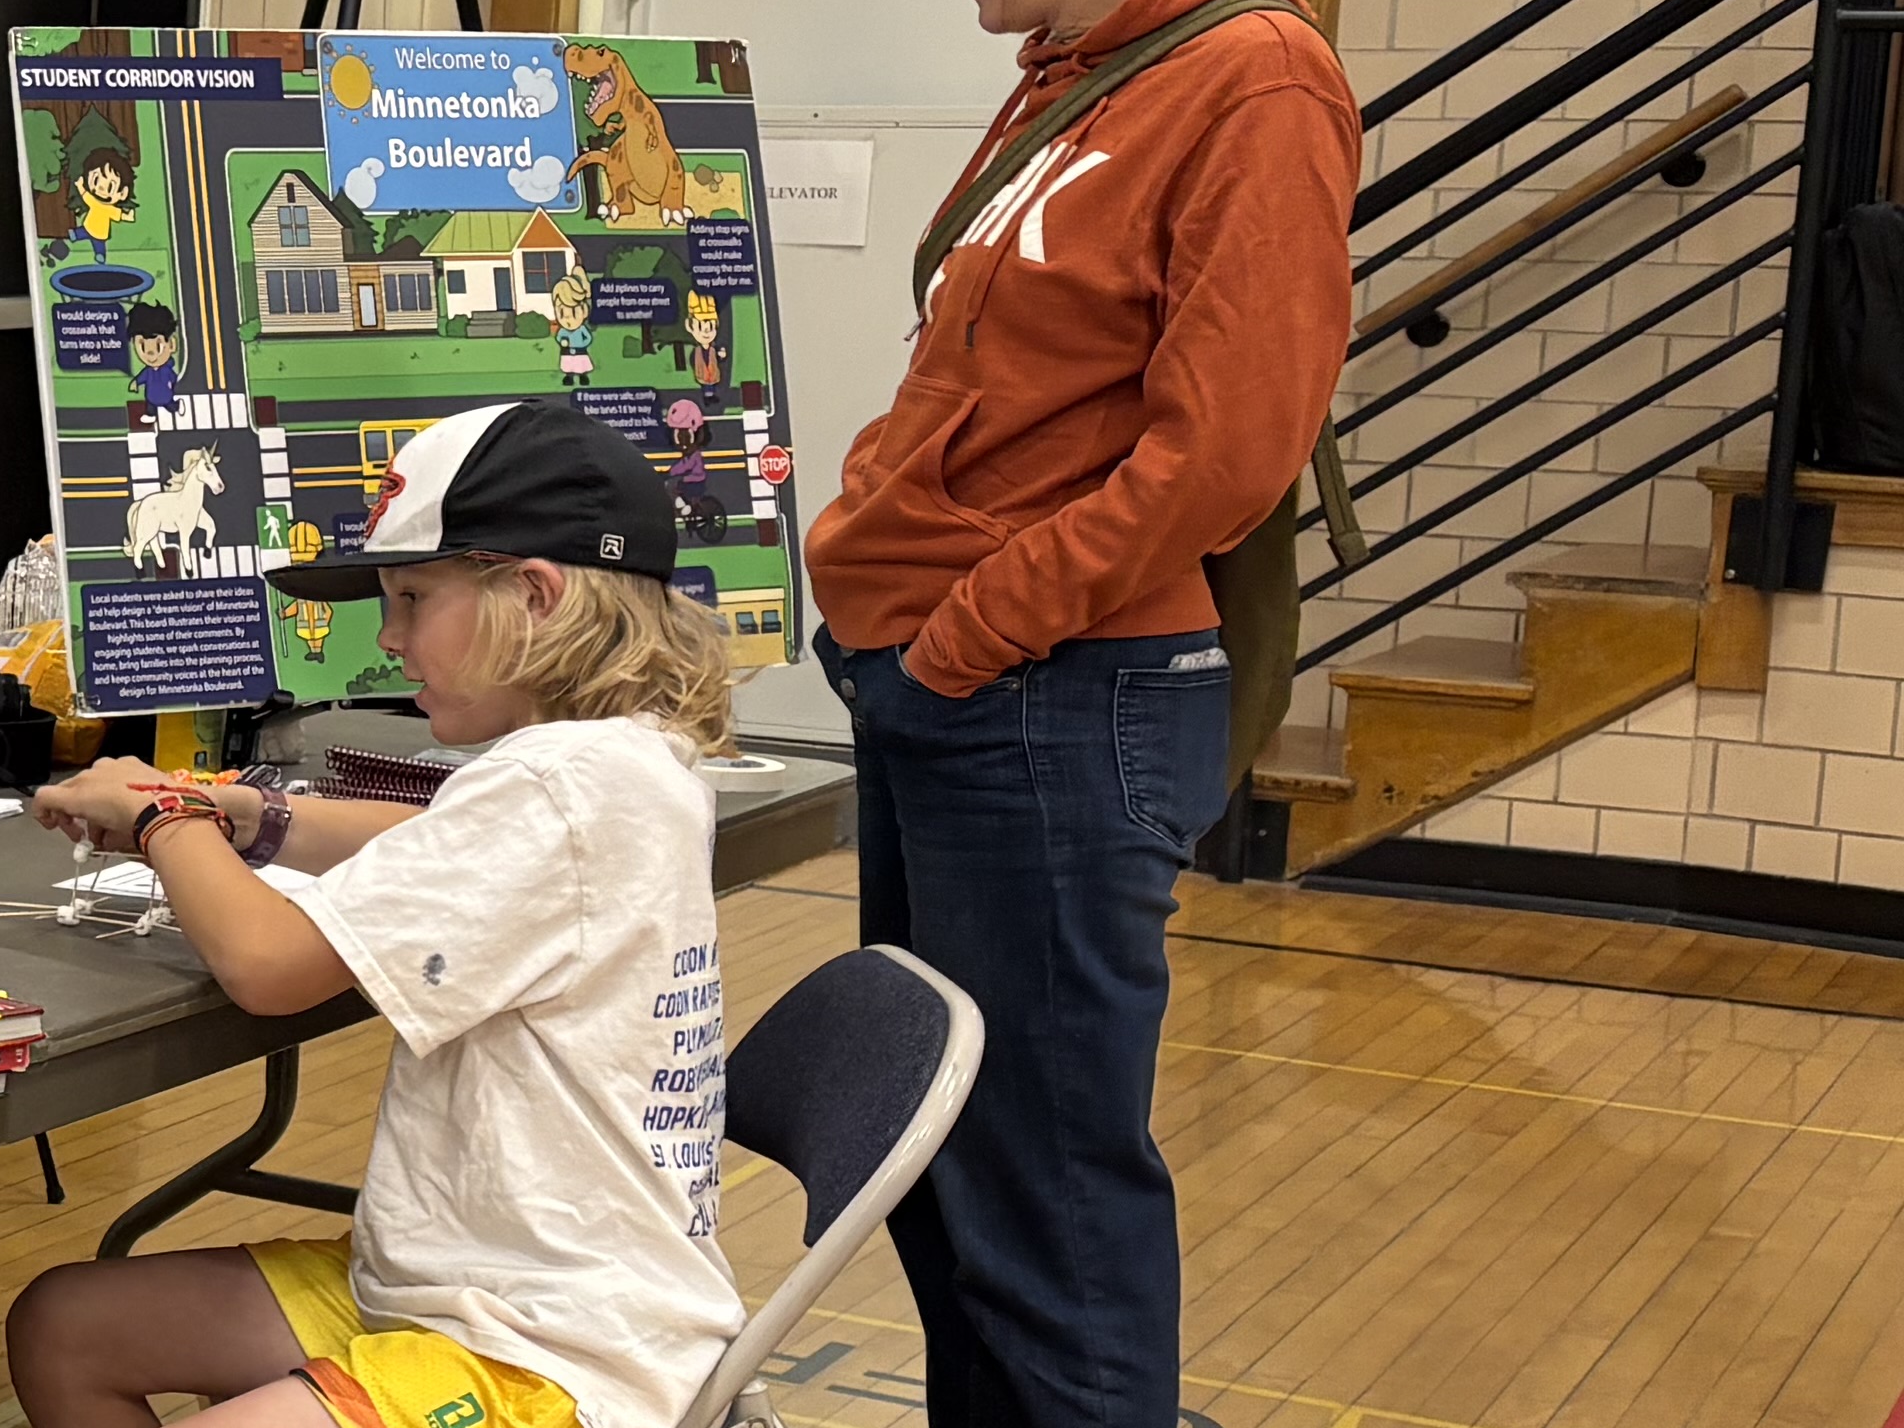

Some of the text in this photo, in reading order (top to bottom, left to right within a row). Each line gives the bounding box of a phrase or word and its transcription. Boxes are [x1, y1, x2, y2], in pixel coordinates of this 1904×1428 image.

[395, 47, 510, 70] Welcome to
[20, 67, 255, 89] STUDENT CORRIDOR VISION
[371, 89, 541, 120] Minnetonka
[388, 137, 531, 169] Boulevard
[767, 186, 838, 200] LEVATOR
[761, 456, 789, 471] STOP
